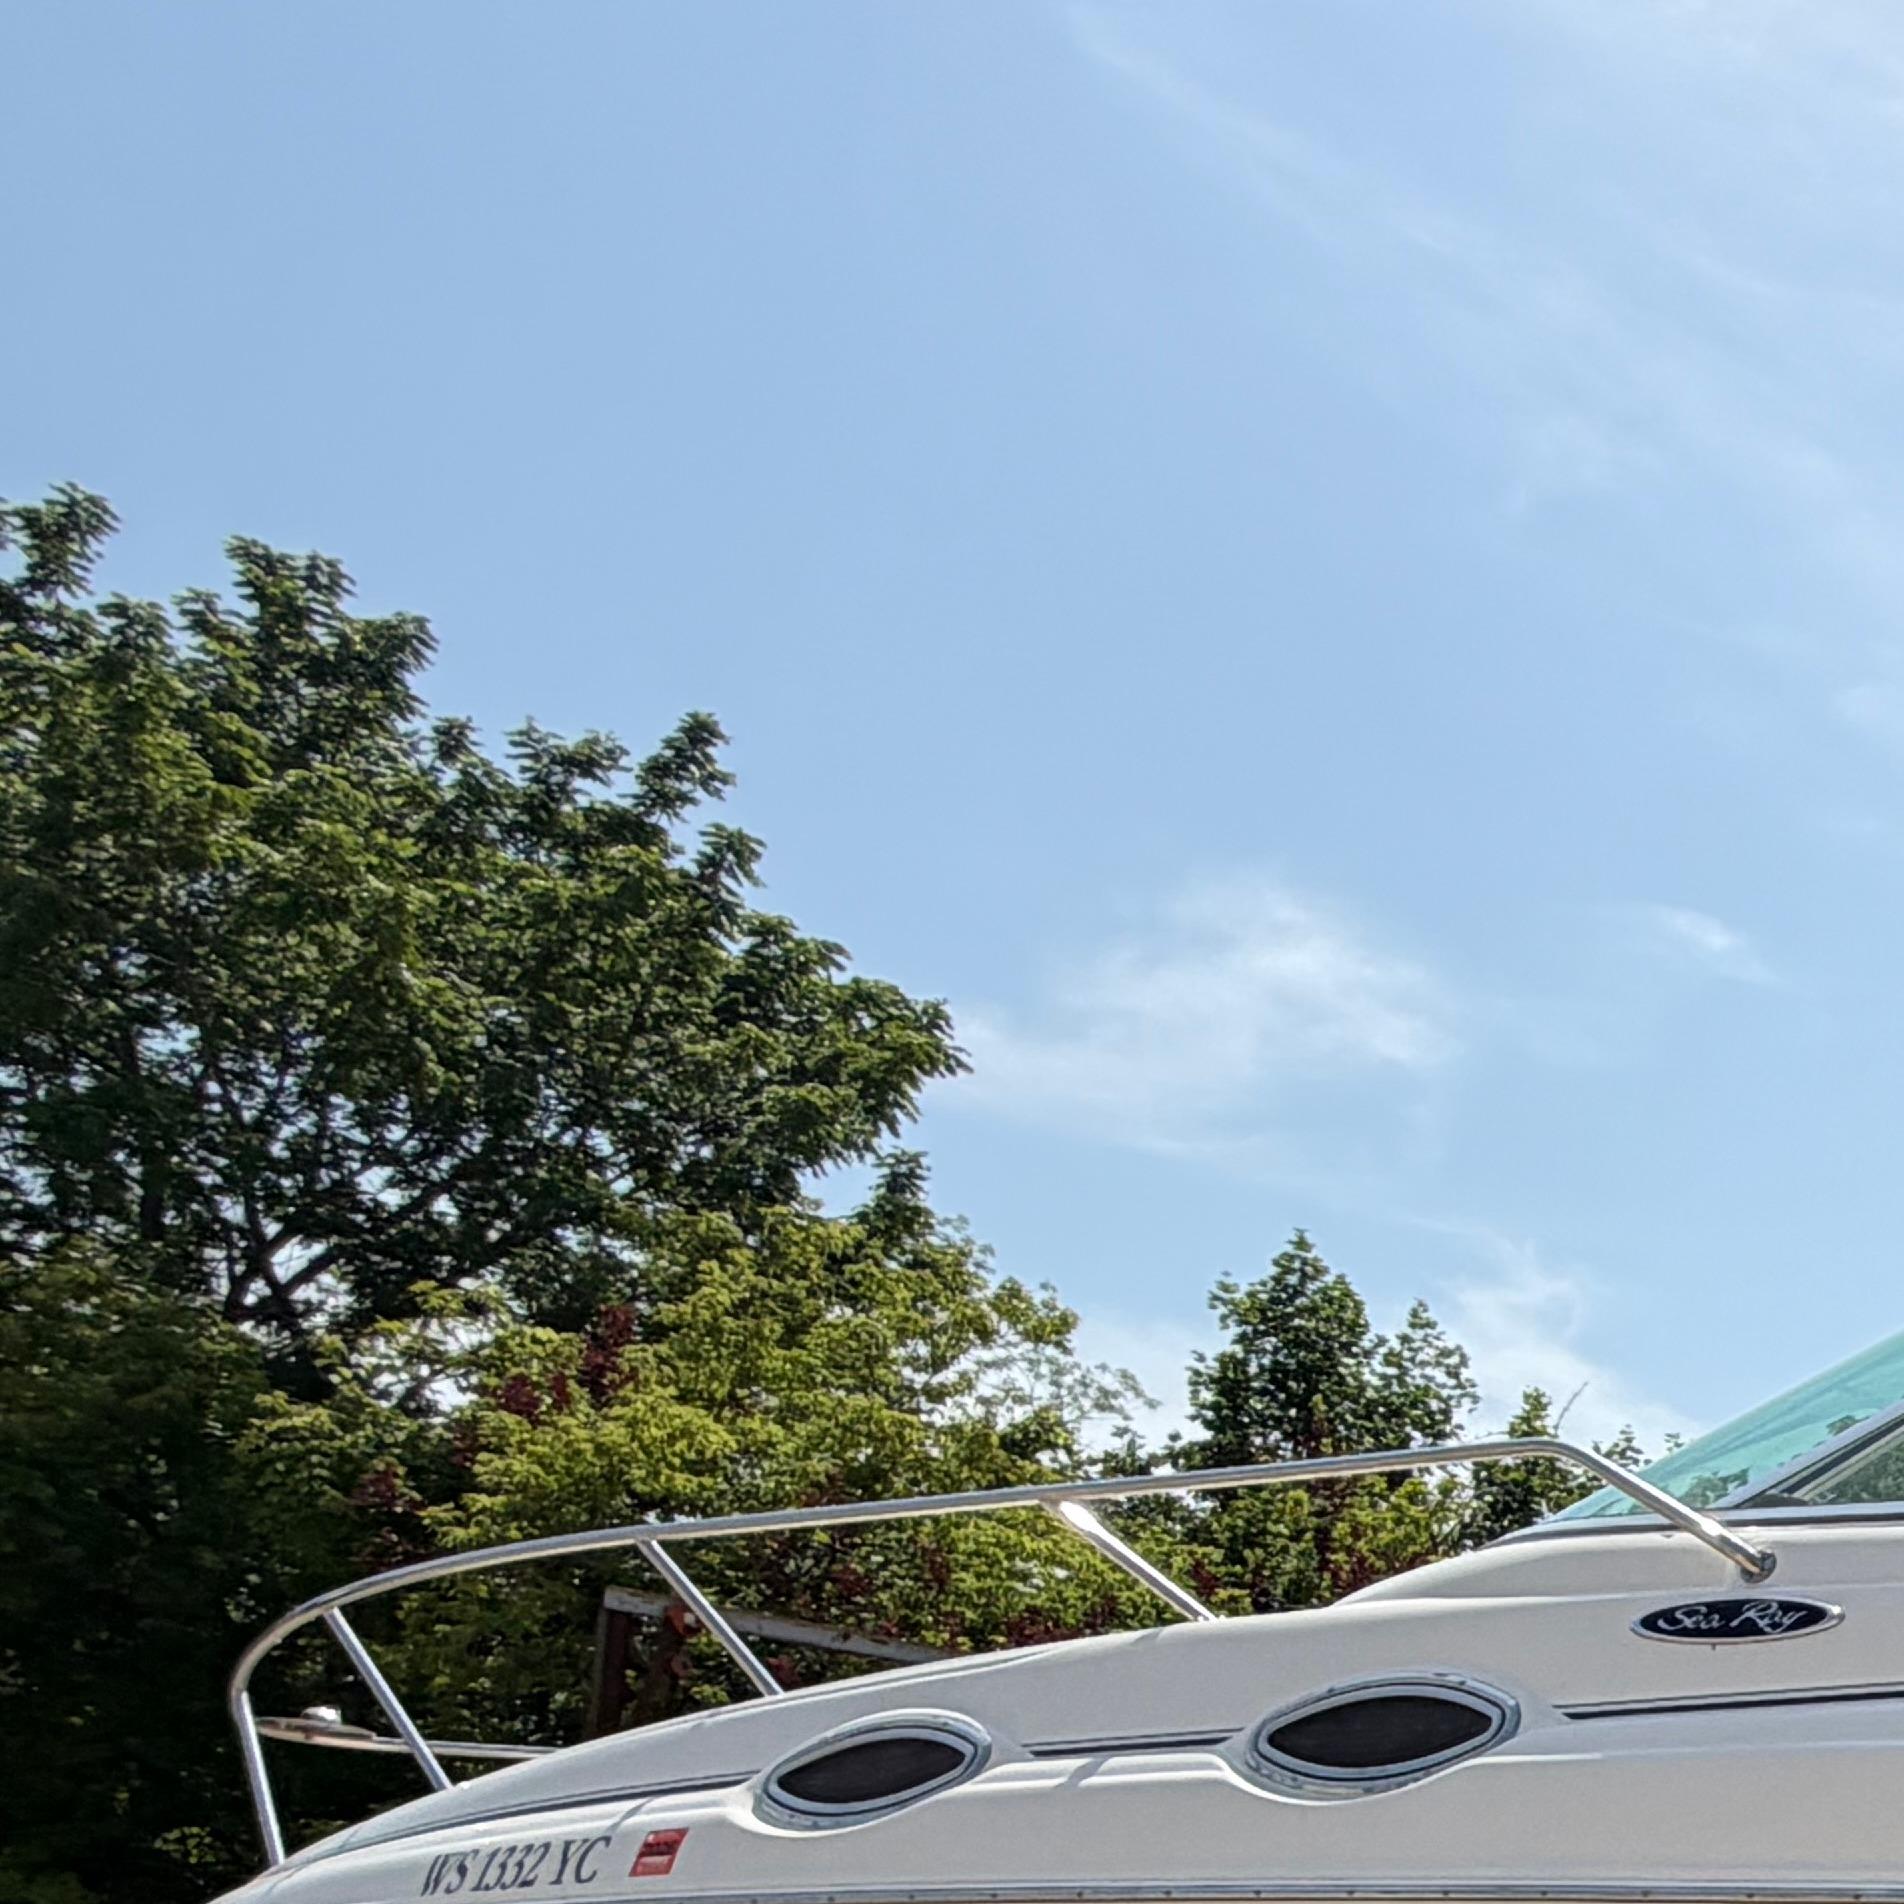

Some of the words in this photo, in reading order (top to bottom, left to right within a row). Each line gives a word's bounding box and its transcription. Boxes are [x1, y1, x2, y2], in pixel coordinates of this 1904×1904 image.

[1657, 1606, 1726, 1631] Sea
[1729, 1600, 1808, 1634] Ray
[420, 1849, 480, 1897] WS
[469, 1841, 552, 1892] 1332
[549, 1835, 613, 1885] YC
